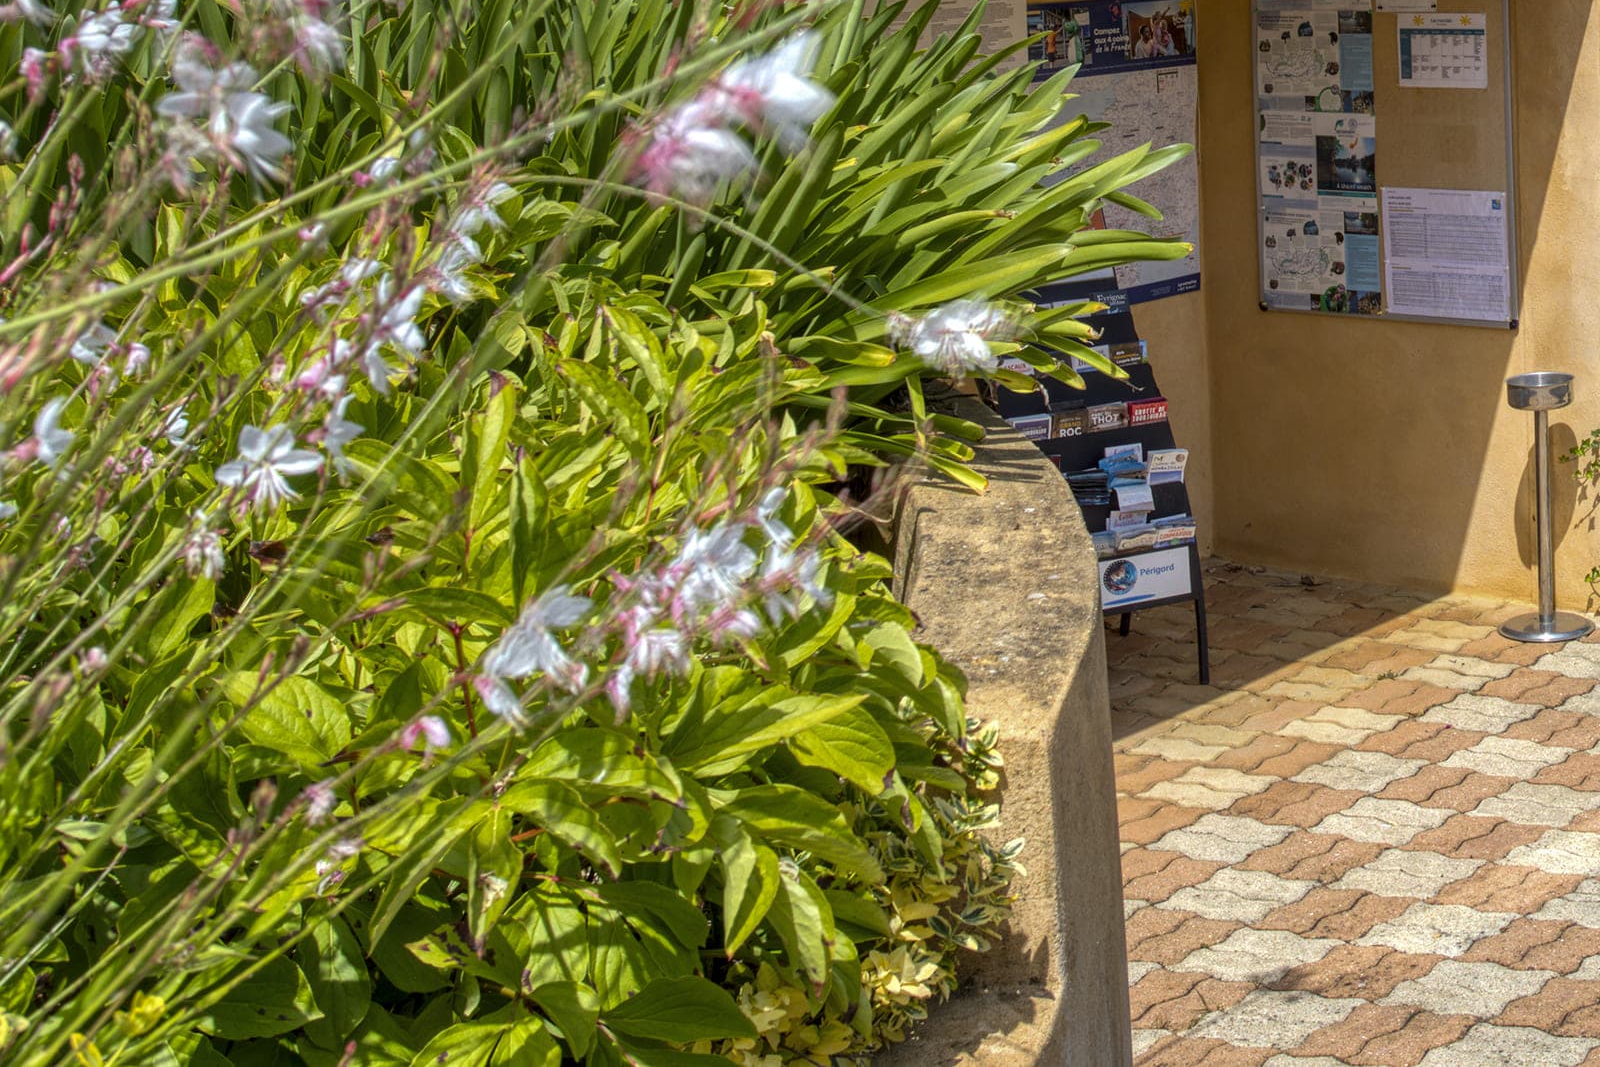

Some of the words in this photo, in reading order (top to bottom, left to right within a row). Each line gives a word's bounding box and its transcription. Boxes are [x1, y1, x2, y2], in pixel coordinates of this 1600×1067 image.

[1091, 413, 1120, 426] THOT
[1059, 427, 1082, 438] ROC
[1140, 563, 1175, 575] Périgord
